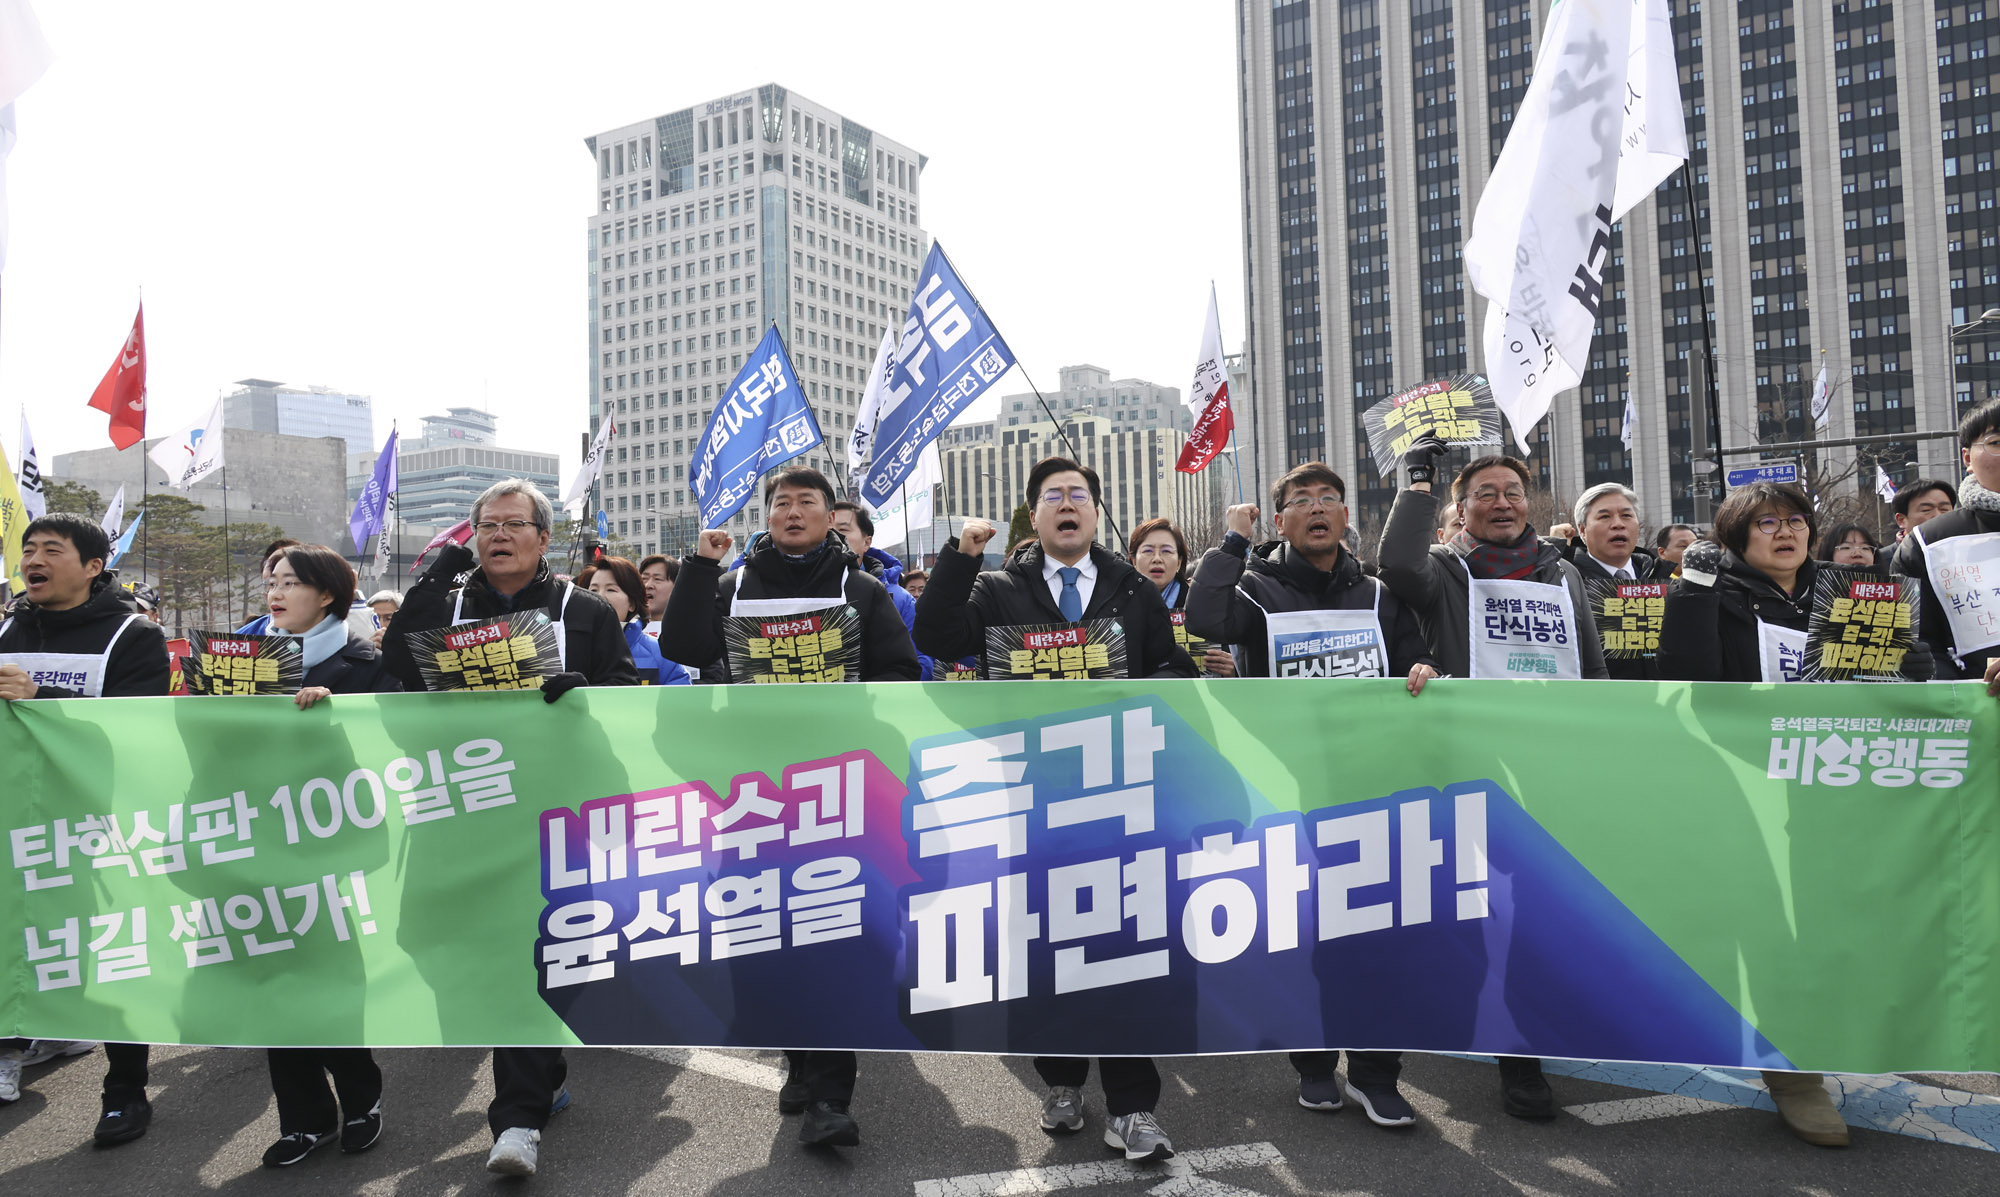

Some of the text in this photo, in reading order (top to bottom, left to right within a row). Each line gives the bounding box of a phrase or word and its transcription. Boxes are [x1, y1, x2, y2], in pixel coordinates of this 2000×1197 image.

[1383, 390, 1474, 430] 윤석열을
[1758, 466, 1794, 476] 세종대로
[1622, 585, 1661, 596] 내란수괴
[1855, 583, 1894, 598] 내란수괴
[1940, 564, 1983, 590] 윤석열
[1485, 598, 1563, 617] 윤석열 즉각파면
[1604, 598, 1665, 616] 윤석열
[1828, 598, 1912, 628] 윤석열을
[1950, 590, 1982, 615] 부산
[450, 624, 502, 647] 내란수괴
[766, 619, 814, 636] 내란수괴
[1029, 630, 1078, 647] 내란수괴
[1485, 614, 1568, 644] 단식농성
[212, 641, 250, 654] 내란수괴
[434, 634, 538, 673] 윤석열을
[748, 628, 842, 658] 윤석열을
[200, 653, 279, 682] 윤석열을
[1010, 644, 1109, 674] 윤석열을
[1507, 658, 1558, 674] 비상행동
[33, 671, 87, 686] 즉각파면
[1767, 732, 1969, 788] 비상행동
[913, 706, 1165, 859] 즉각
[10, 738, 517, 892] 탄핵심판 100일을
[548, 759, 865, 890] 내란수괴
[909, 791, 1489, 1014] 파면하라!
[24, 870, 377, 992] 넘길 셈인가!
[543, 856, 866, 989] 윤석열을
